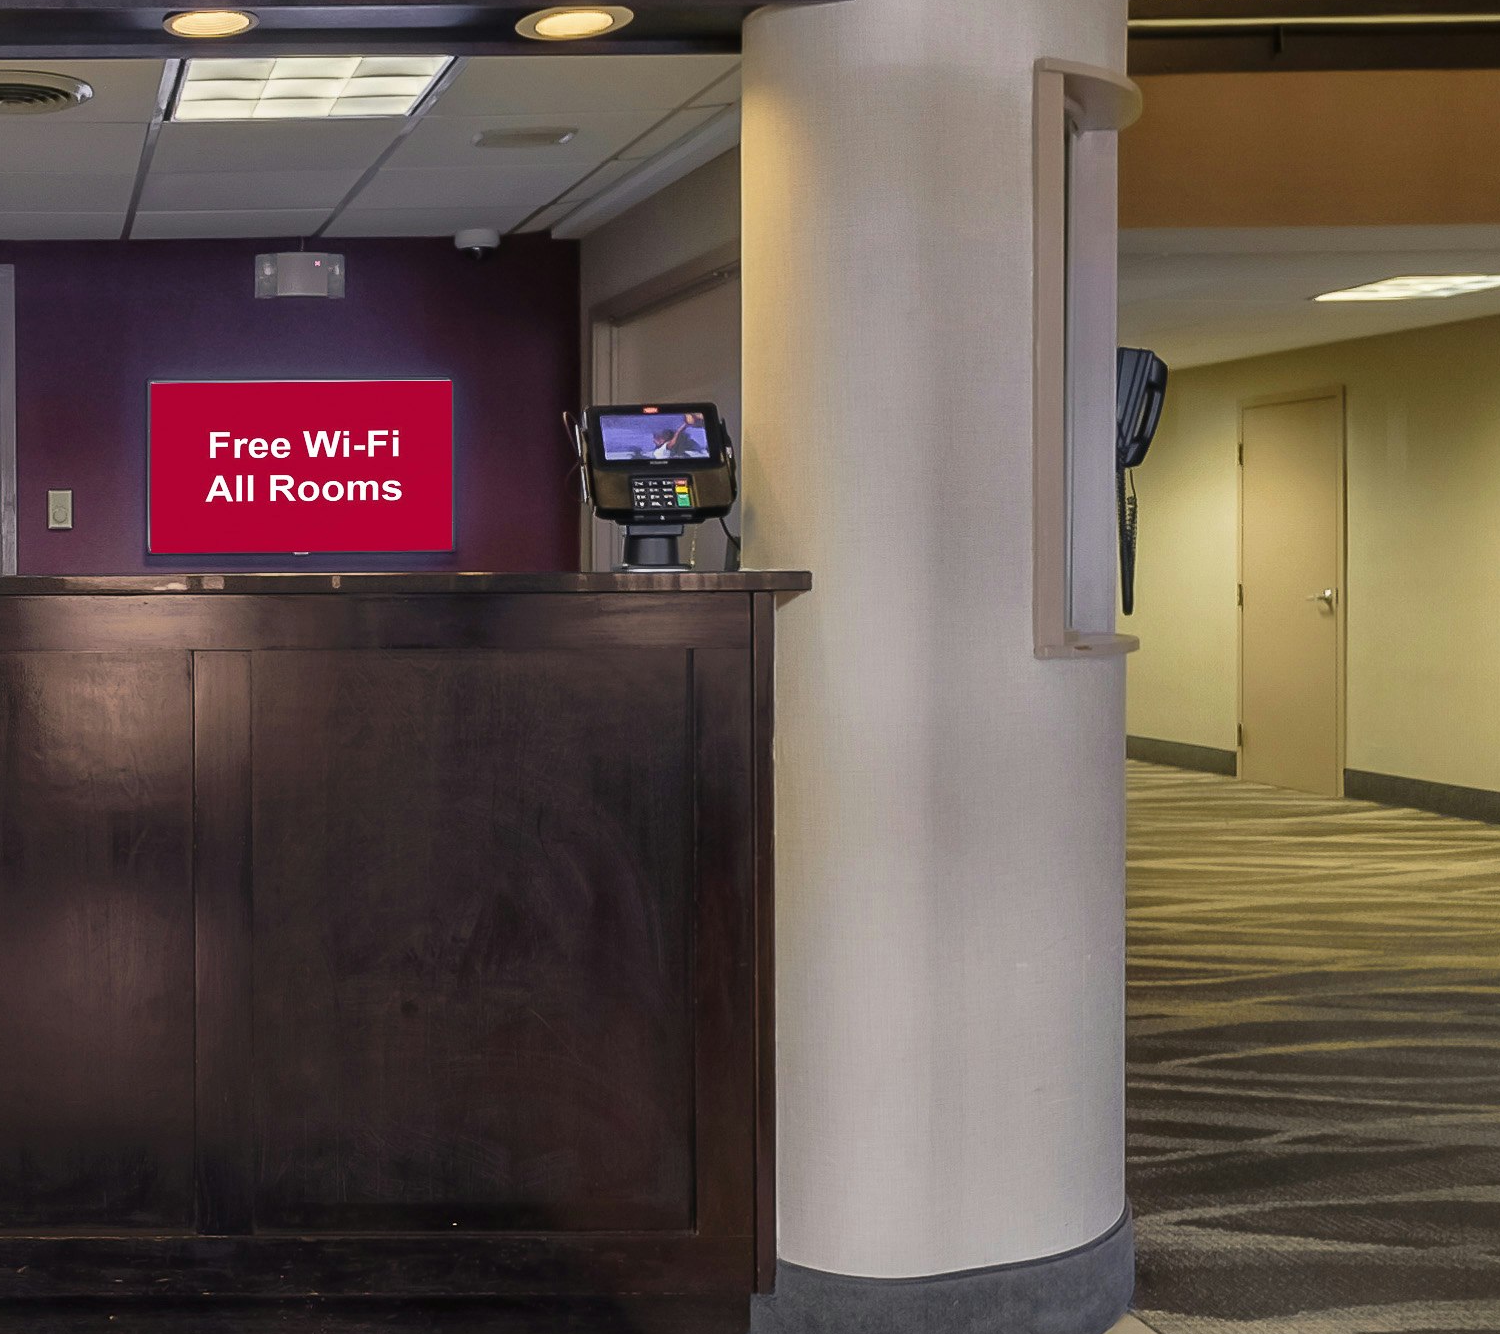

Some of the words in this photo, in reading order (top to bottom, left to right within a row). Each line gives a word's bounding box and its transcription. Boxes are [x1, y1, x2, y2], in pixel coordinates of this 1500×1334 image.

[209, 431, 291, 459] Free
[302, 429, 400, 458] Wi-Fi
[205, 474, 254, 503] All
[269, 474, 403, 503] Rooms
